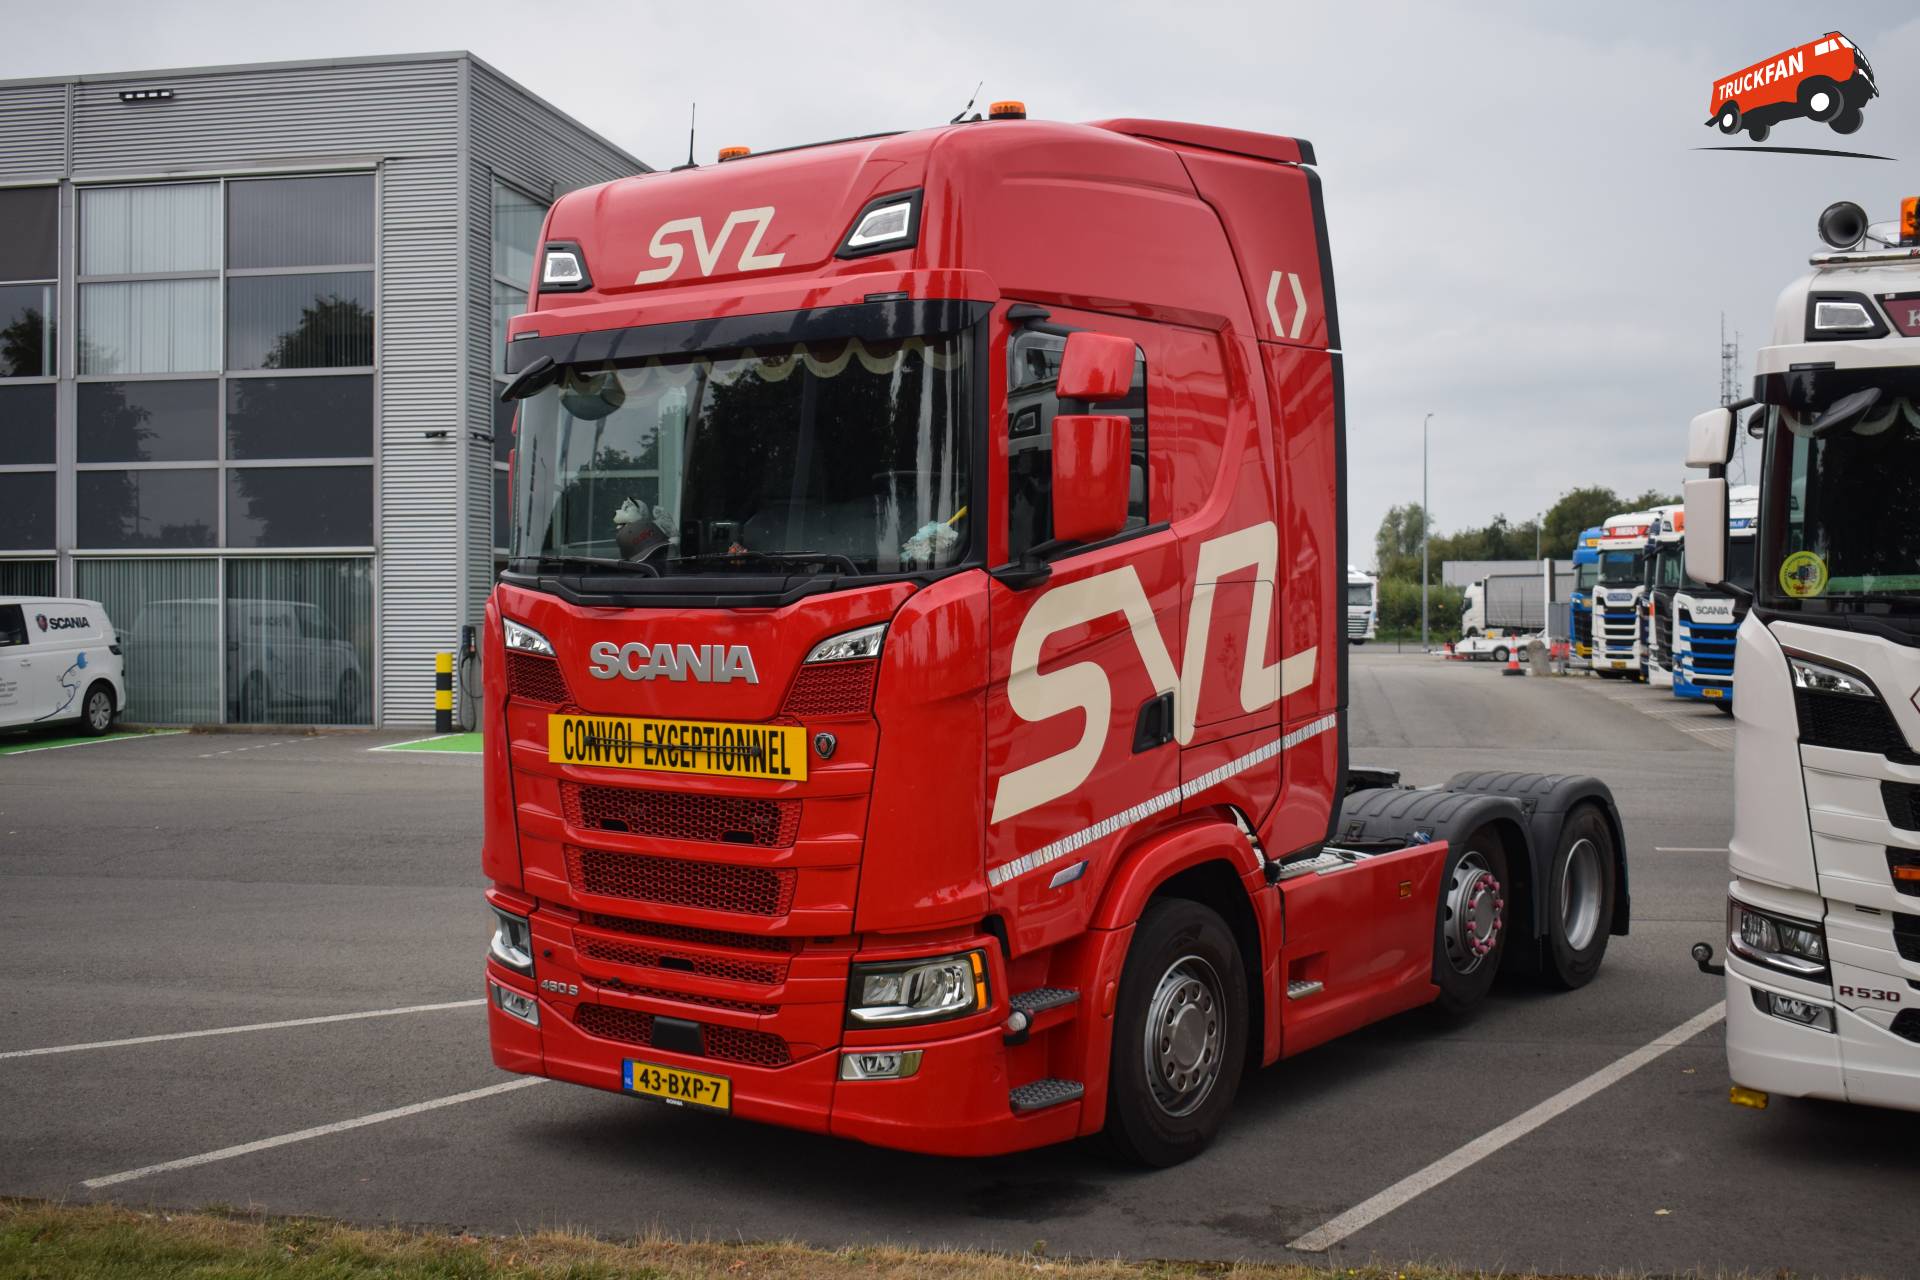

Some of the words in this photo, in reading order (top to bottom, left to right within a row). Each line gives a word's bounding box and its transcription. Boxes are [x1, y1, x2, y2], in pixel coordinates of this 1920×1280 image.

[634, 205, 786, 285] SVZ
[49, 616, 91, 630] SCANIA
[1695, 606, 1729, 615] SCANIA
[588, 640, 760, 685] SCANIA
[990, 520, 1318, 825] SVZ
[562, 718, 633, 764] CONVOI
[643, 723, 791, 776] EXCEPTIONNEL
[540, 979, 567, 994] 460
[1839, 985, 1854, 997] R
[1857, 987, 1901, 1002] 530
[639, 1068, 721, 1103] 43-BXP-7
